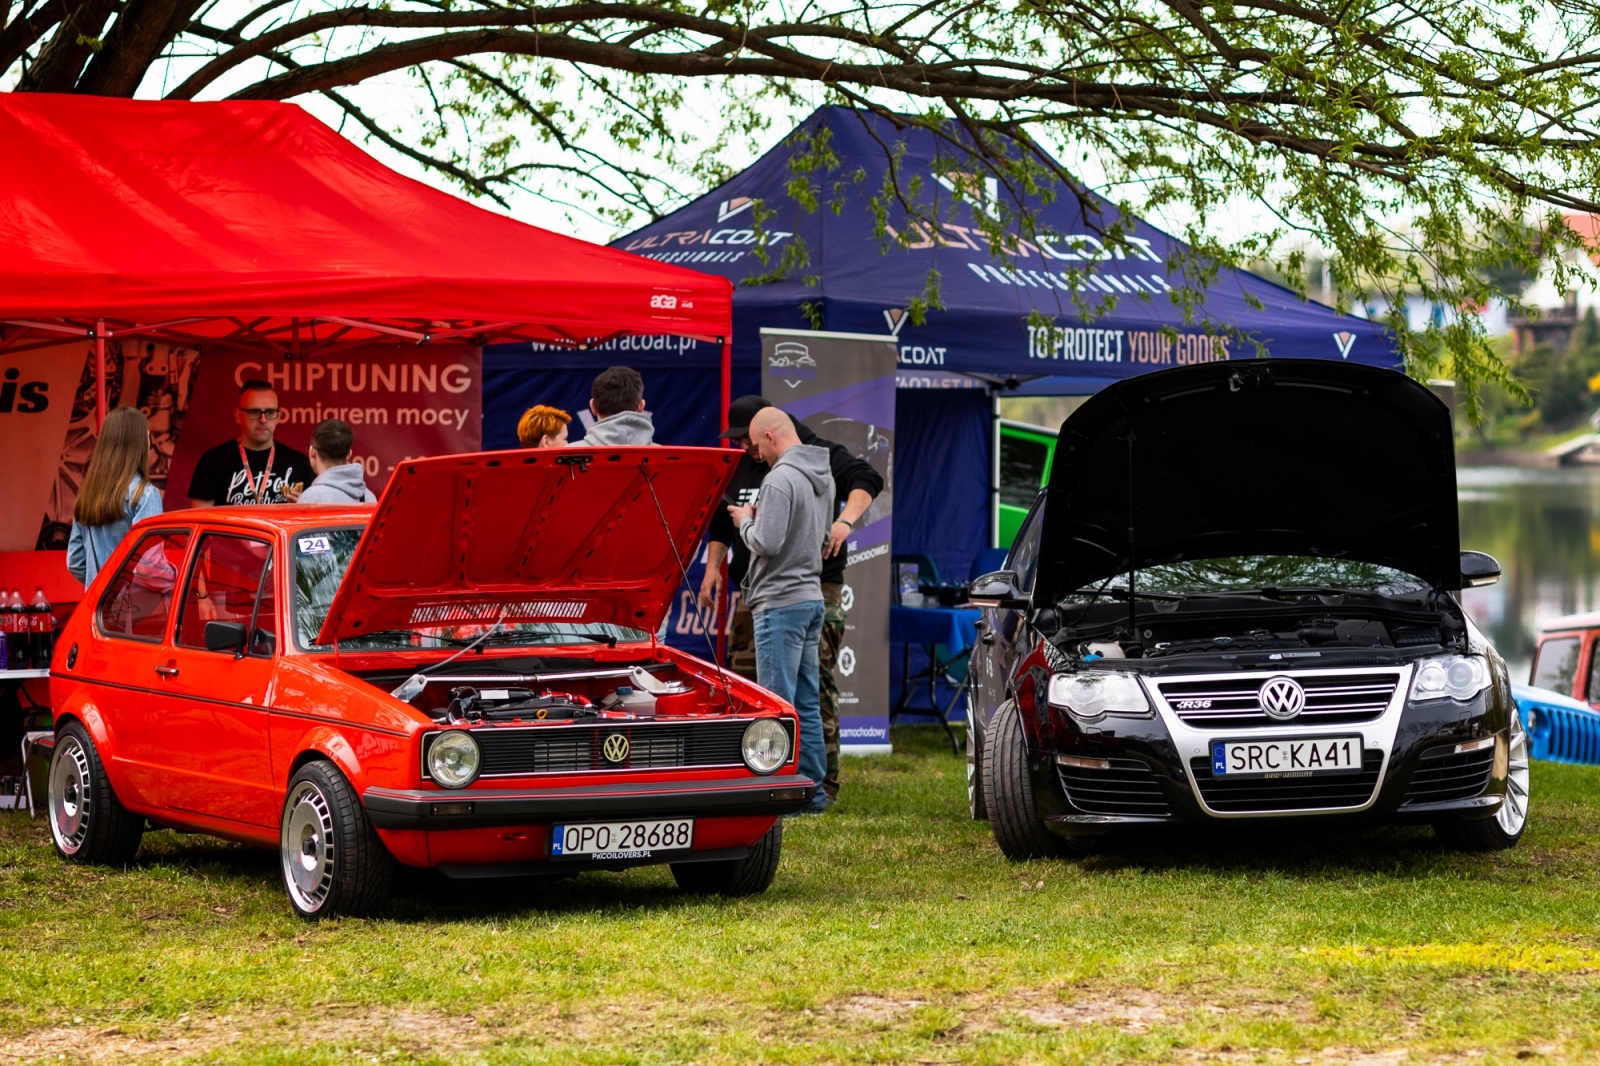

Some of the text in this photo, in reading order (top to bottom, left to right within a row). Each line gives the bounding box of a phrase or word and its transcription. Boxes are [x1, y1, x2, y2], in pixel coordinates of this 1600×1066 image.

[896, 345, 947, 366] COAT
[1027, 325, 1230, 365] TO PROTECT YOUR GOODS
[234, 361, 472, 394] CHIPTUNING
[396, 408, 470, 430] mocy
[304, 539, 325, 551] 24
[1230, 741, 1351, 770] SRC KA41
[565, 822, 689, 851] OPO 28688
